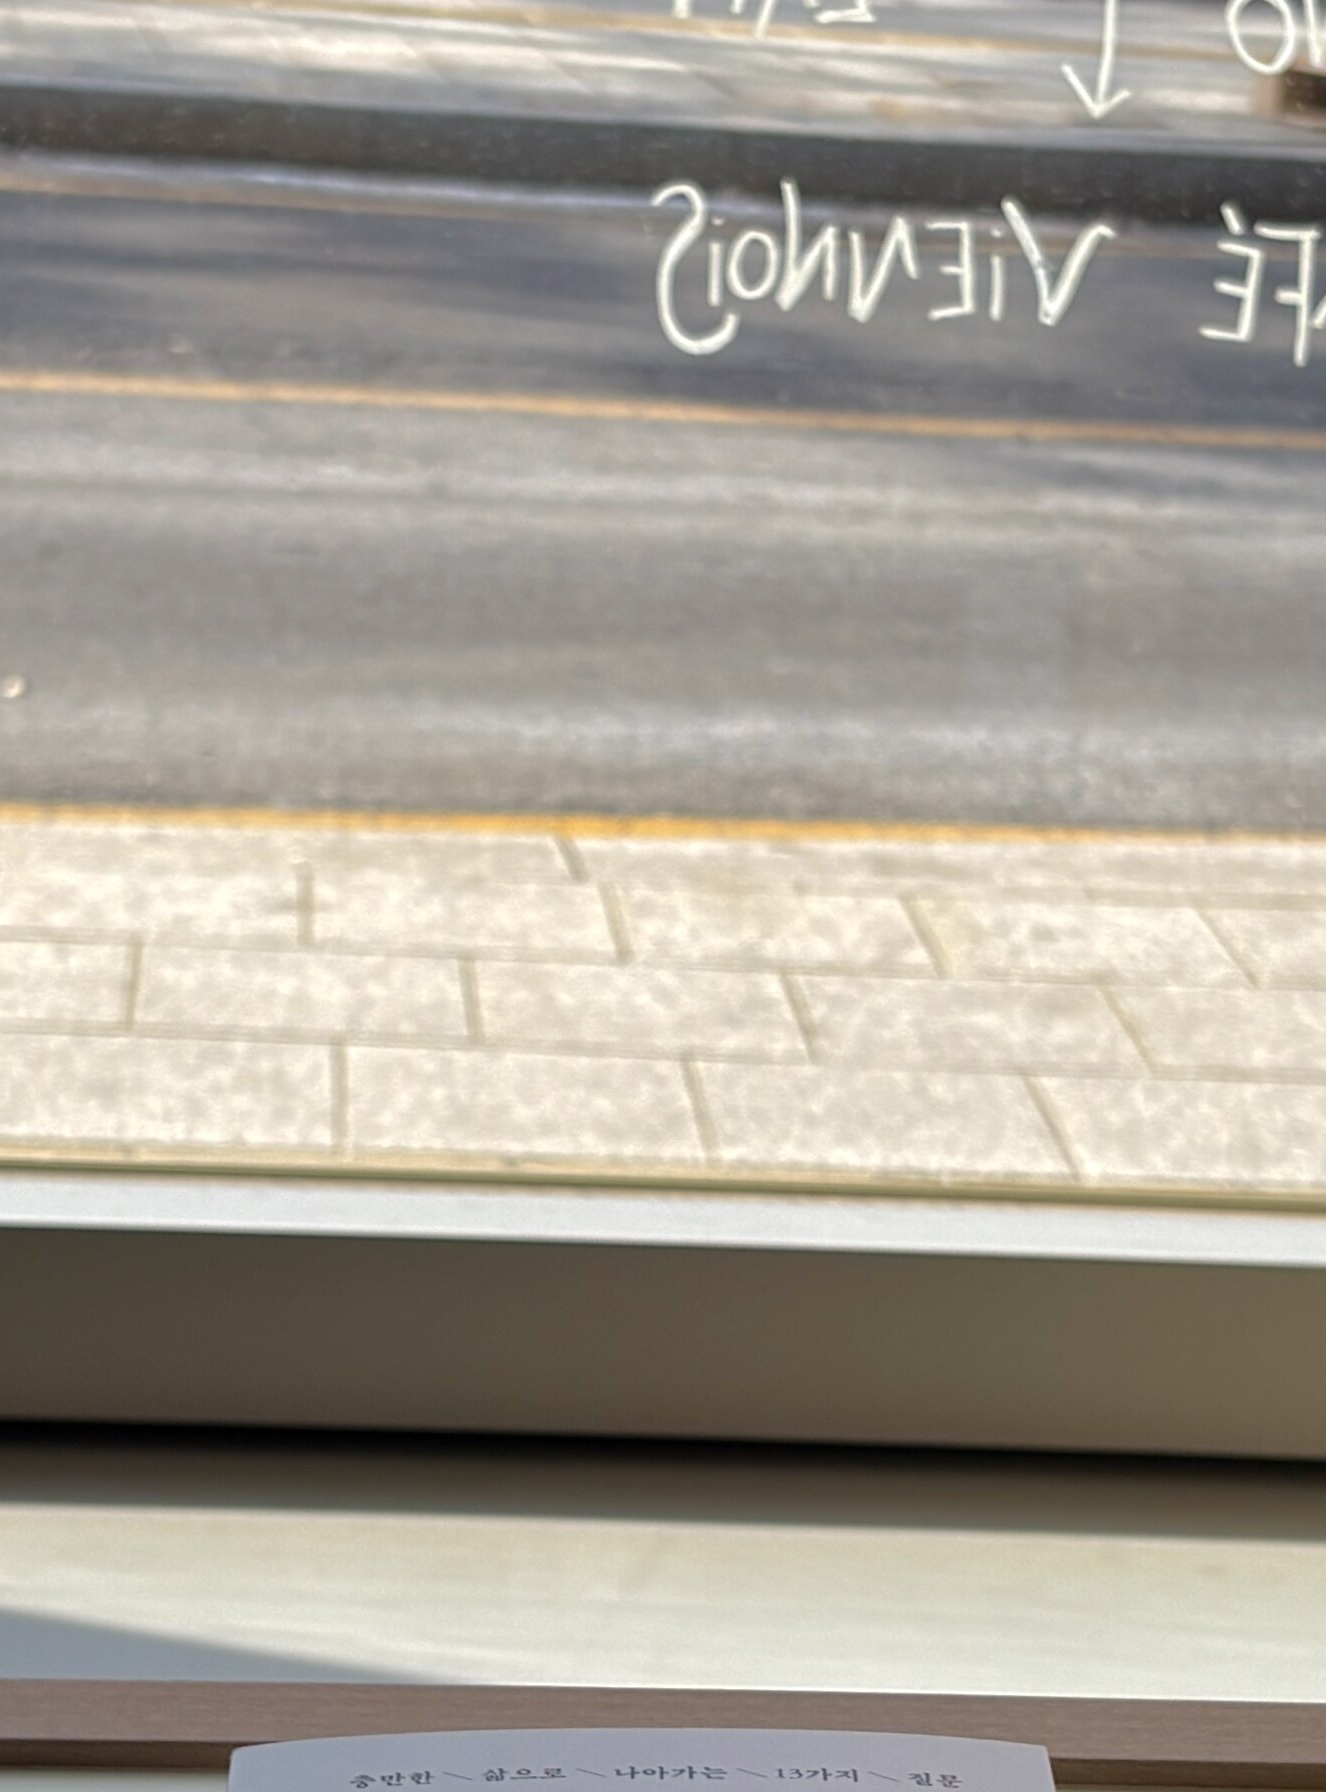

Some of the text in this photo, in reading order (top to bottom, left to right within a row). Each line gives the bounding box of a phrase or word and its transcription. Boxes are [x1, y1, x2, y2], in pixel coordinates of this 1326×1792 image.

[350, 1765, 963, 1790] 충만한 삶으로 나아가는 13가지 질문
